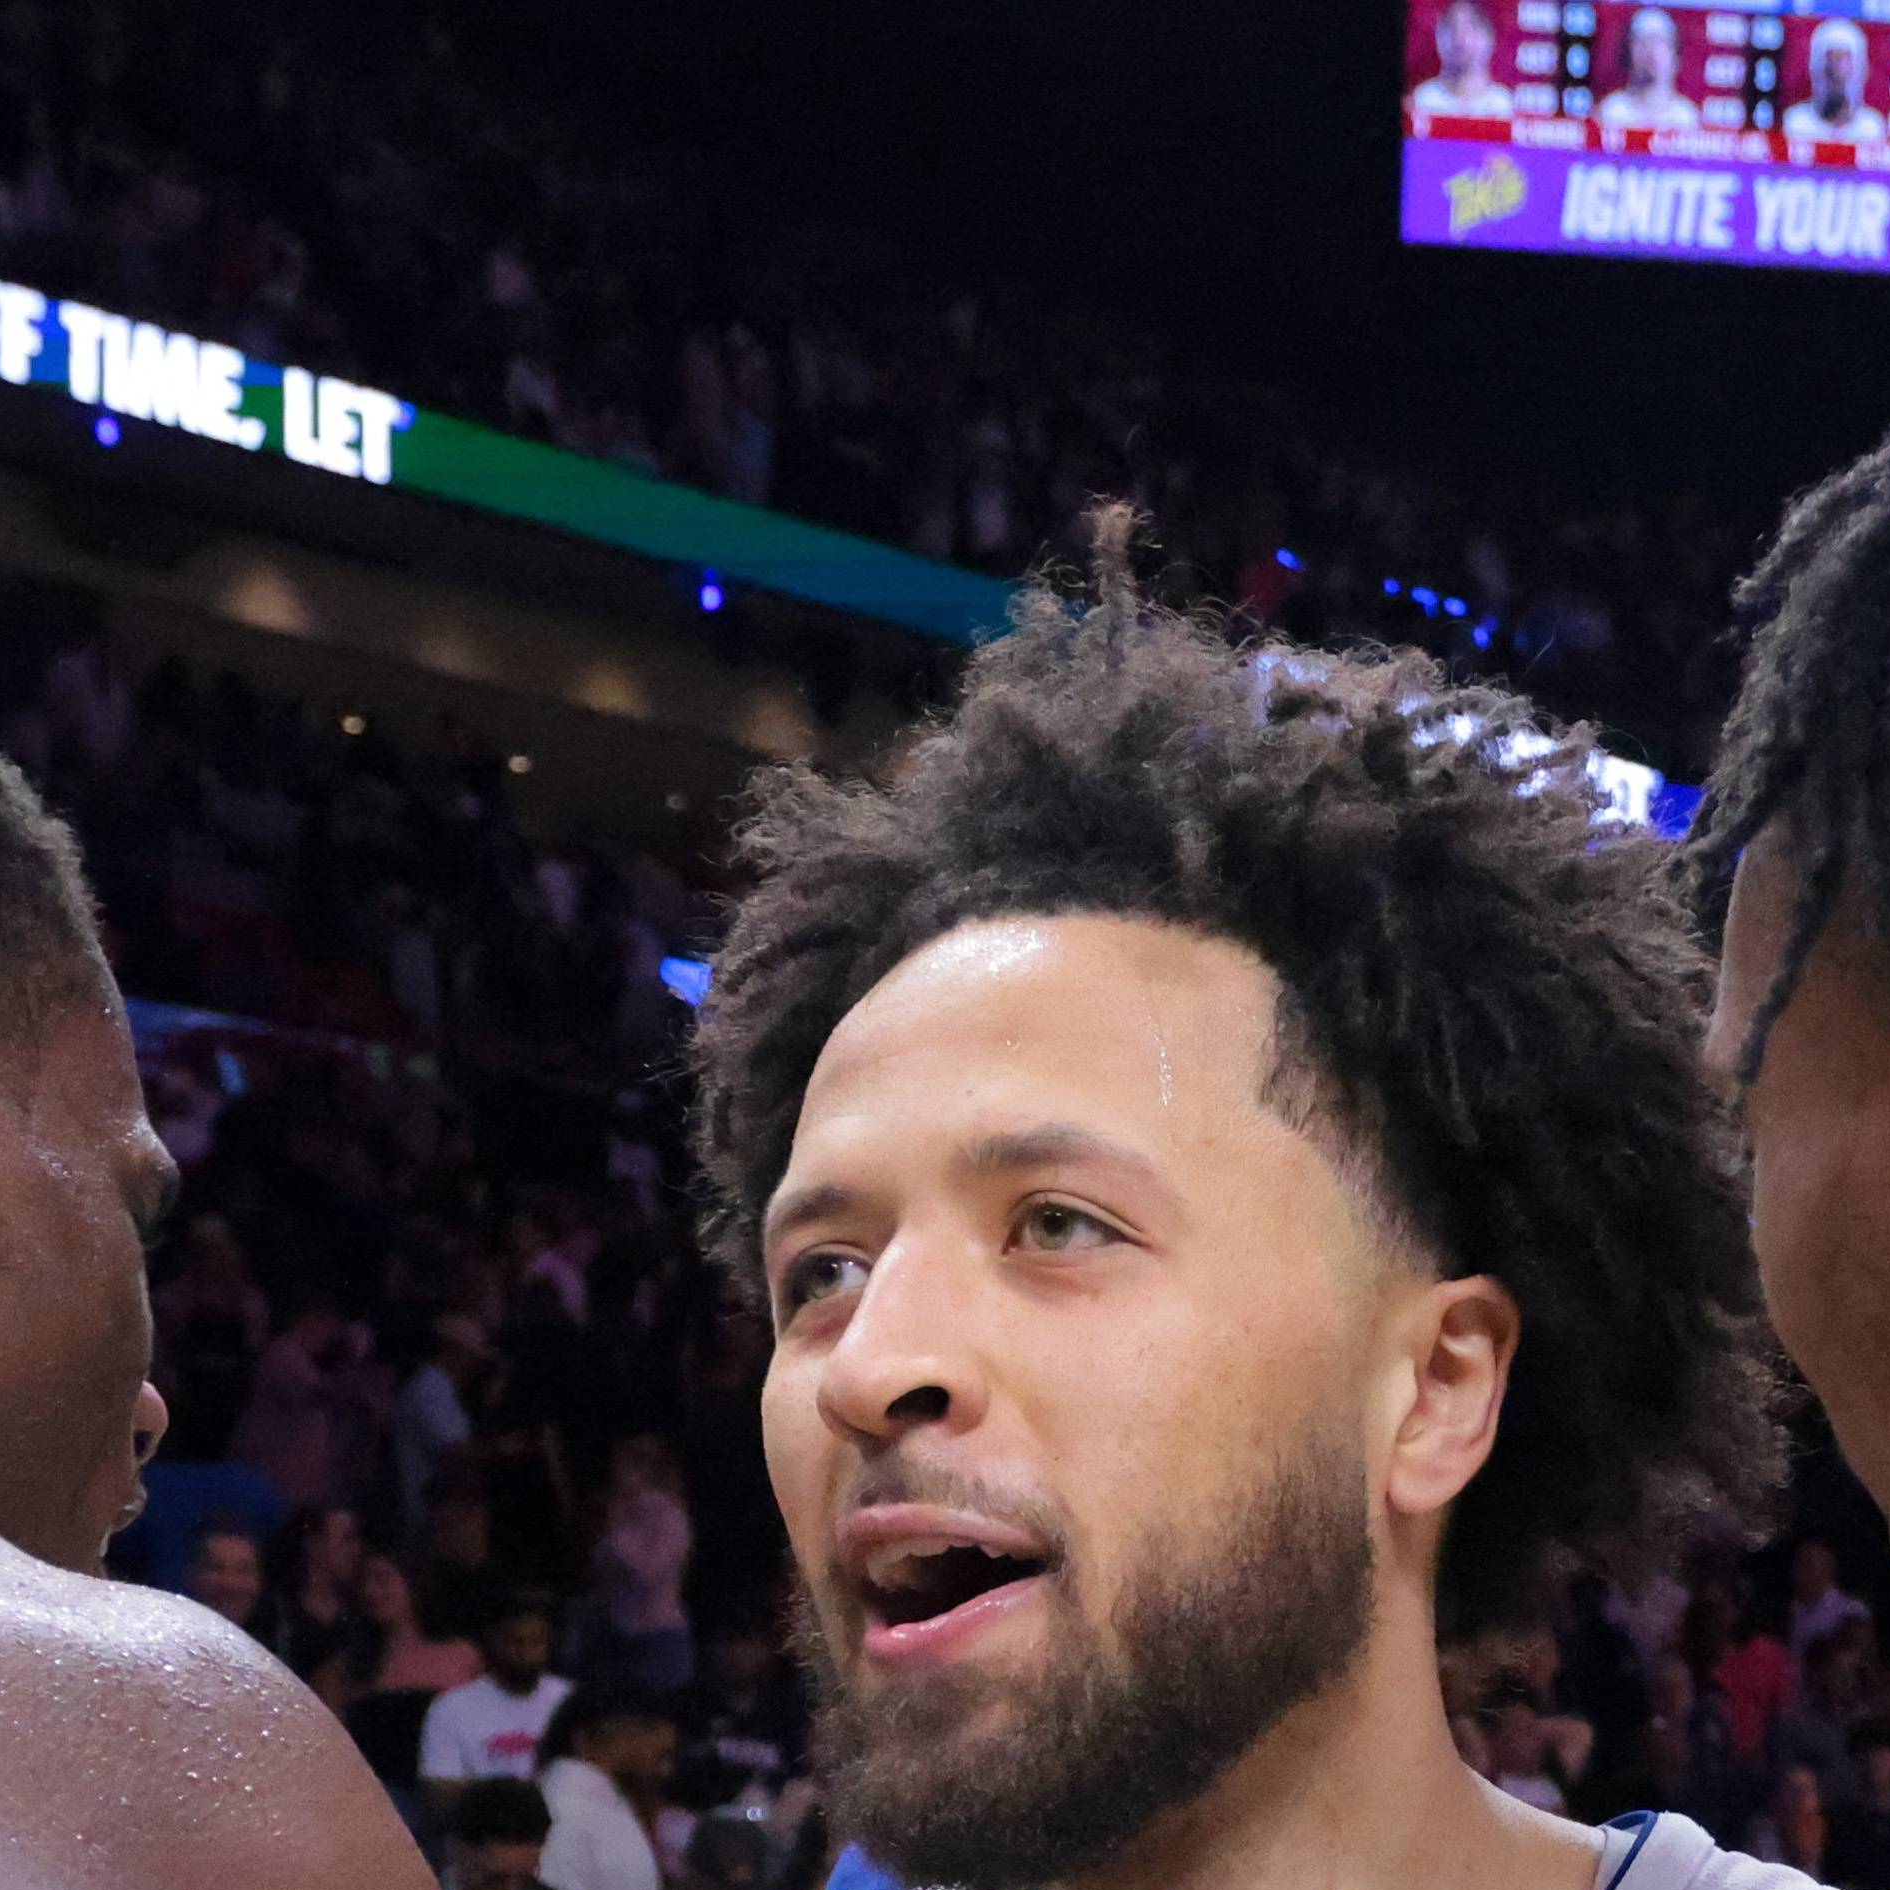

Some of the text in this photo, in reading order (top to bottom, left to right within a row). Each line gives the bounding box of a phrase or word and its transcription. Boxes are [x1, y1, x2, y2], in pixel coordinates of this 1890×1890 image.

[1561, 162, 1739, 250] IGNITE
[59, 298, 267, 452] TIME.
[281, 366, 405, 485] LET
